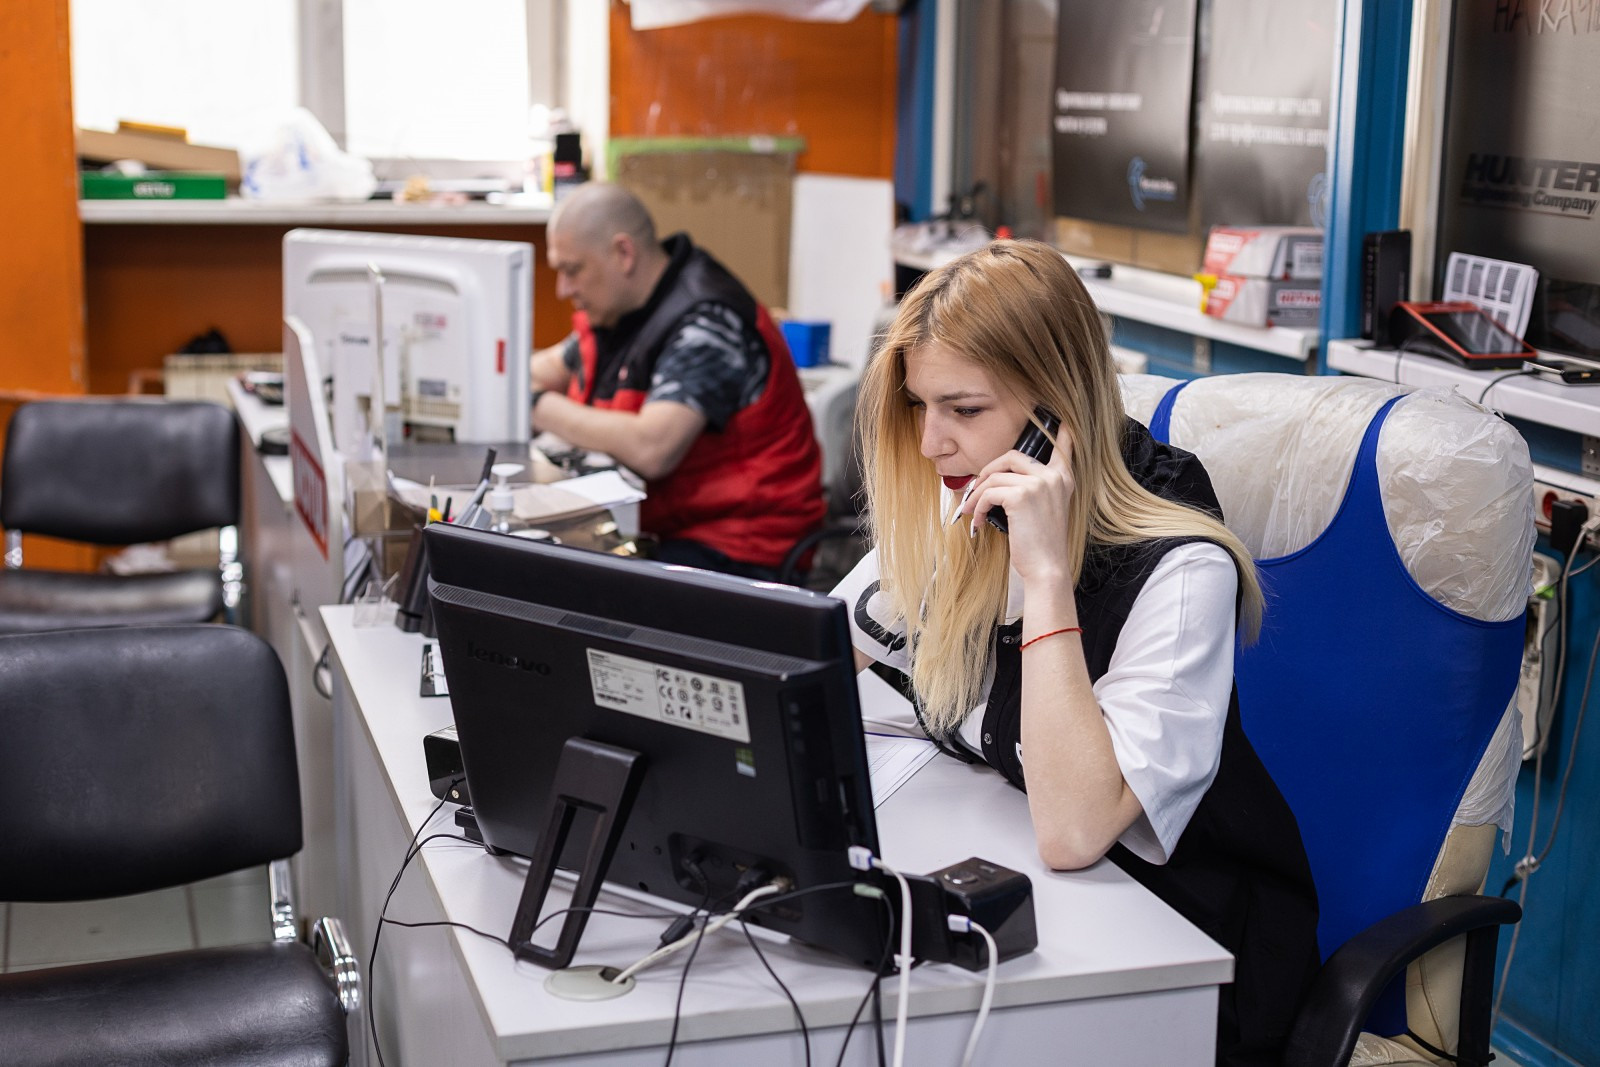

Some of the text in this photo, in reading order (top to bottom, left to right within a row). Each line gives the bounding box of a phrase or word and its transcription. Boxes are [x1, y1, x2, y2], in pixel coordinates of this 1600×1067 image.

[1537, 0, 1600, 35] КАЧ
[1465, 153, 1600, 193] HUNTER
[1533, 190, 1597, 214] Company
[467, 641, 551, 676] lenovo
